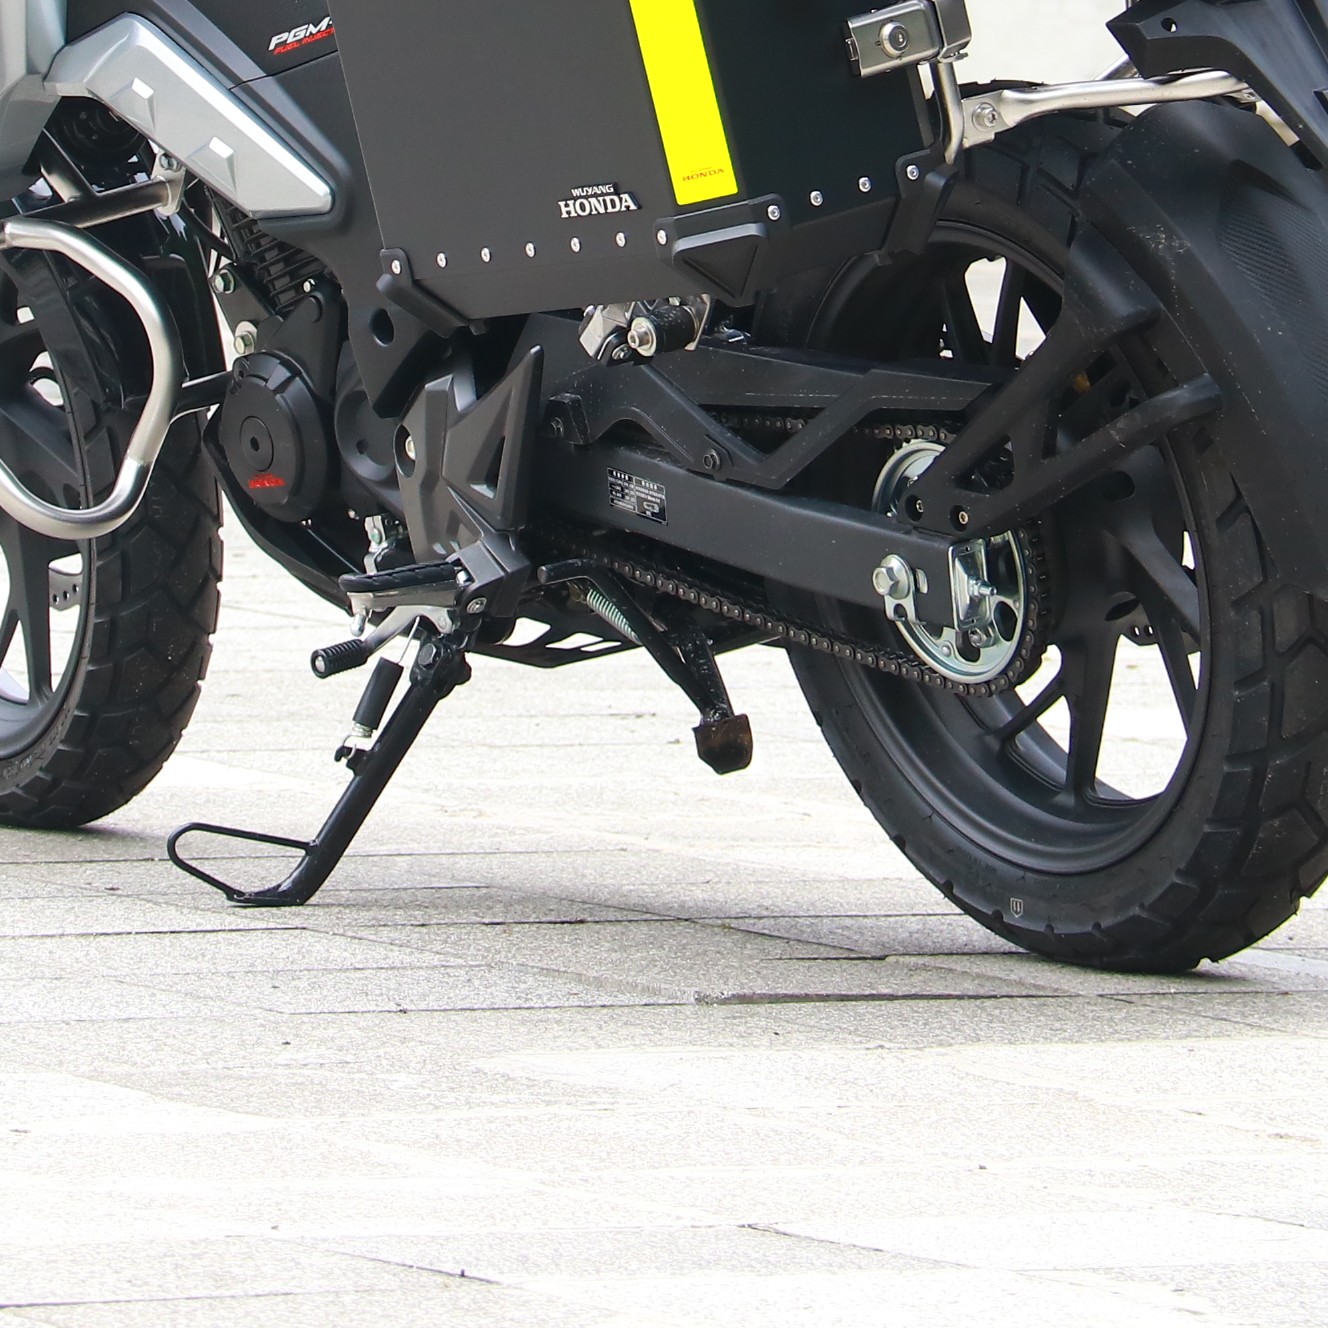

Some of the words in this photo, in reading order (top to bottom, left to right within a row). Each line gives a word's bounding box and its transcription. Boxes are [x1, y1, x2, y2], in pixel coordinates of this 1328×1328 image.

[682, 168, 725, 182] HONDA
[571, 184, 614, 197] WUYANG
[558, 193, 638, 219] HONDA
